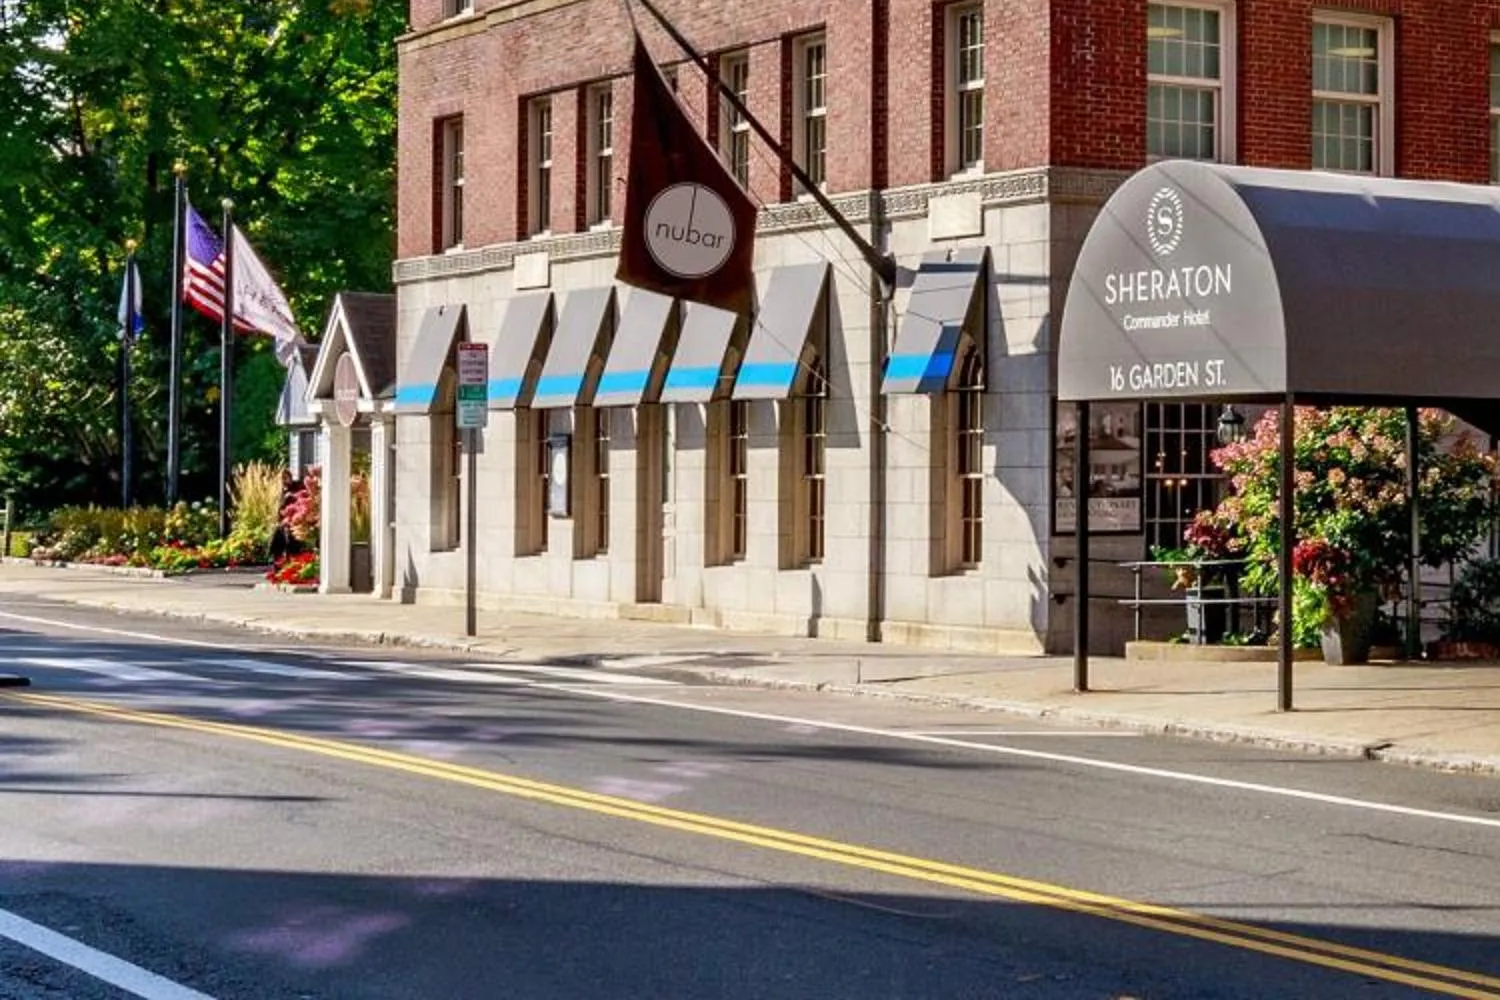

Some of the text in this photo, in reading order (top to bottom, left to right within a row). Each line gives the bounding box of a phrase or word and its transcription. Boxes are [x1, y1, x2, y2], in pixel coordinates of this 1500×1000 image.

[1156, 206, 1174, 236] S
[1105, 263, 1232, 304] SHERATON
[1123, 309, 1211, 331] Commander Hotel
[1109, 359, 1227, 391] 16 GARDEN ST.
